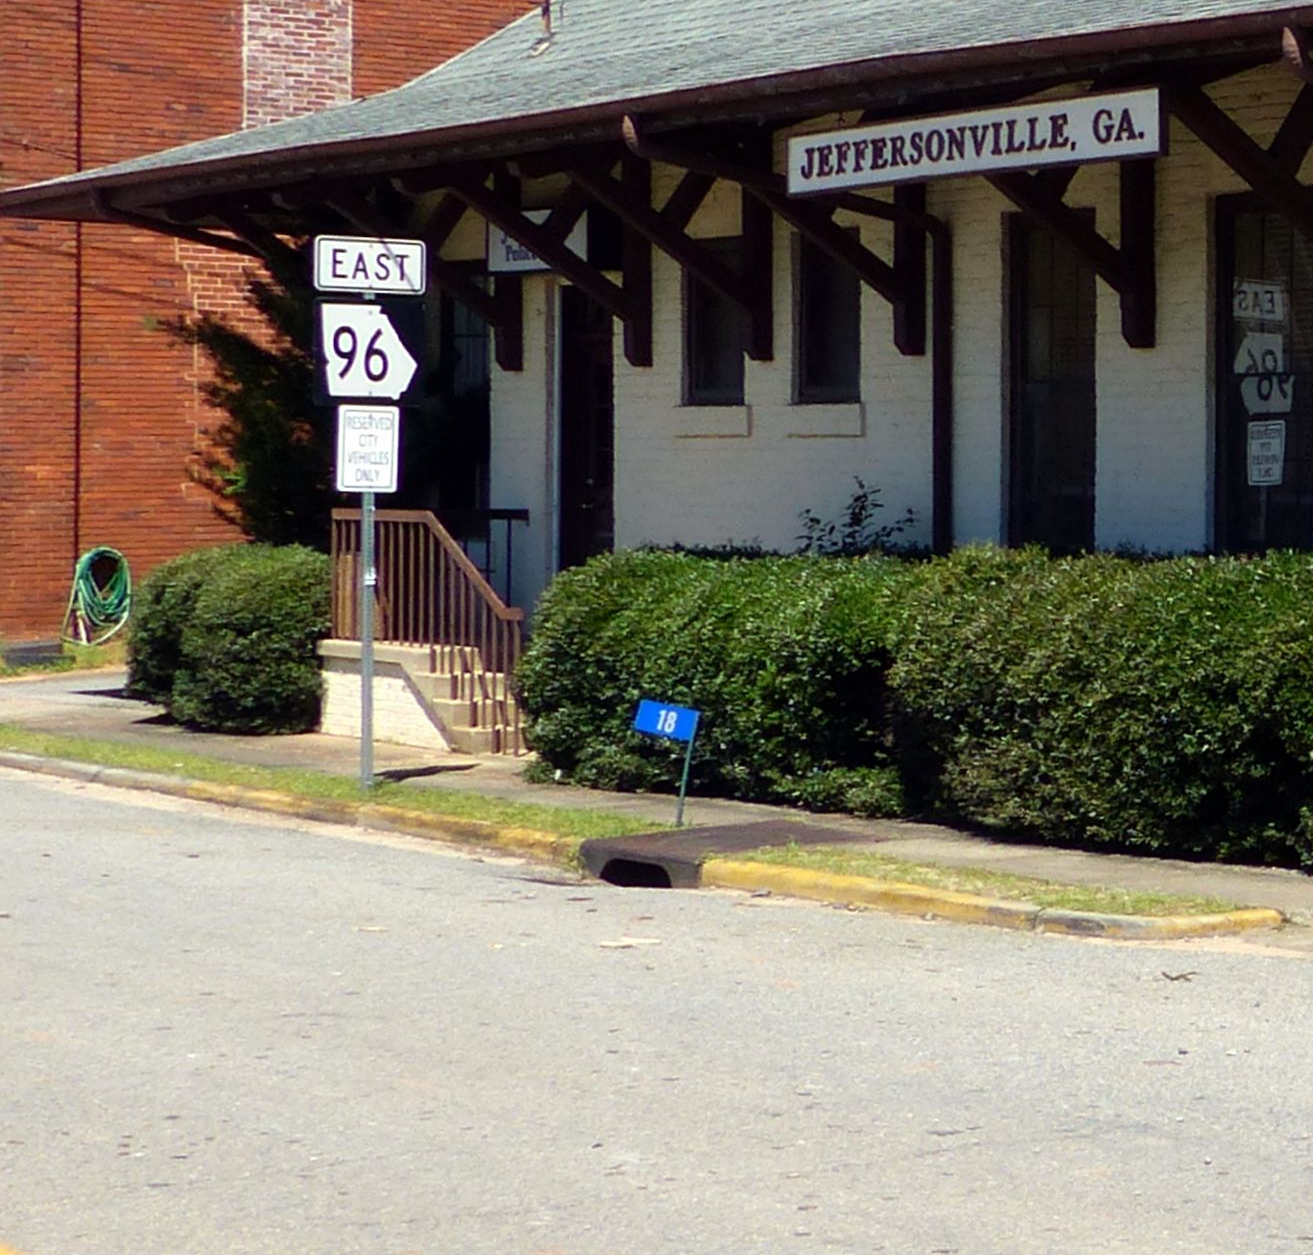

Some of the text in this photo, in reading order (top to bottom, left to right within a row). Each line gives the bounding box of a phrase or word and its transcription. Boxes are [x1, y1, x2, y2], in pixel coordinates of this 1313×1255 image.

[801, 107, 1145, 180] JEFFERSONVILLE, GA.
[332, 248, 411, 282] EAST
[332, 325, 389, 382] 96
[347, 416, 393, 431] RESERVED
[359, 433, 378, 448] CITY
[348, 450, 389, 466] VEHICLES
[355, 467, 379, 483] ONLY
[656, 709, 678, 733] 18
